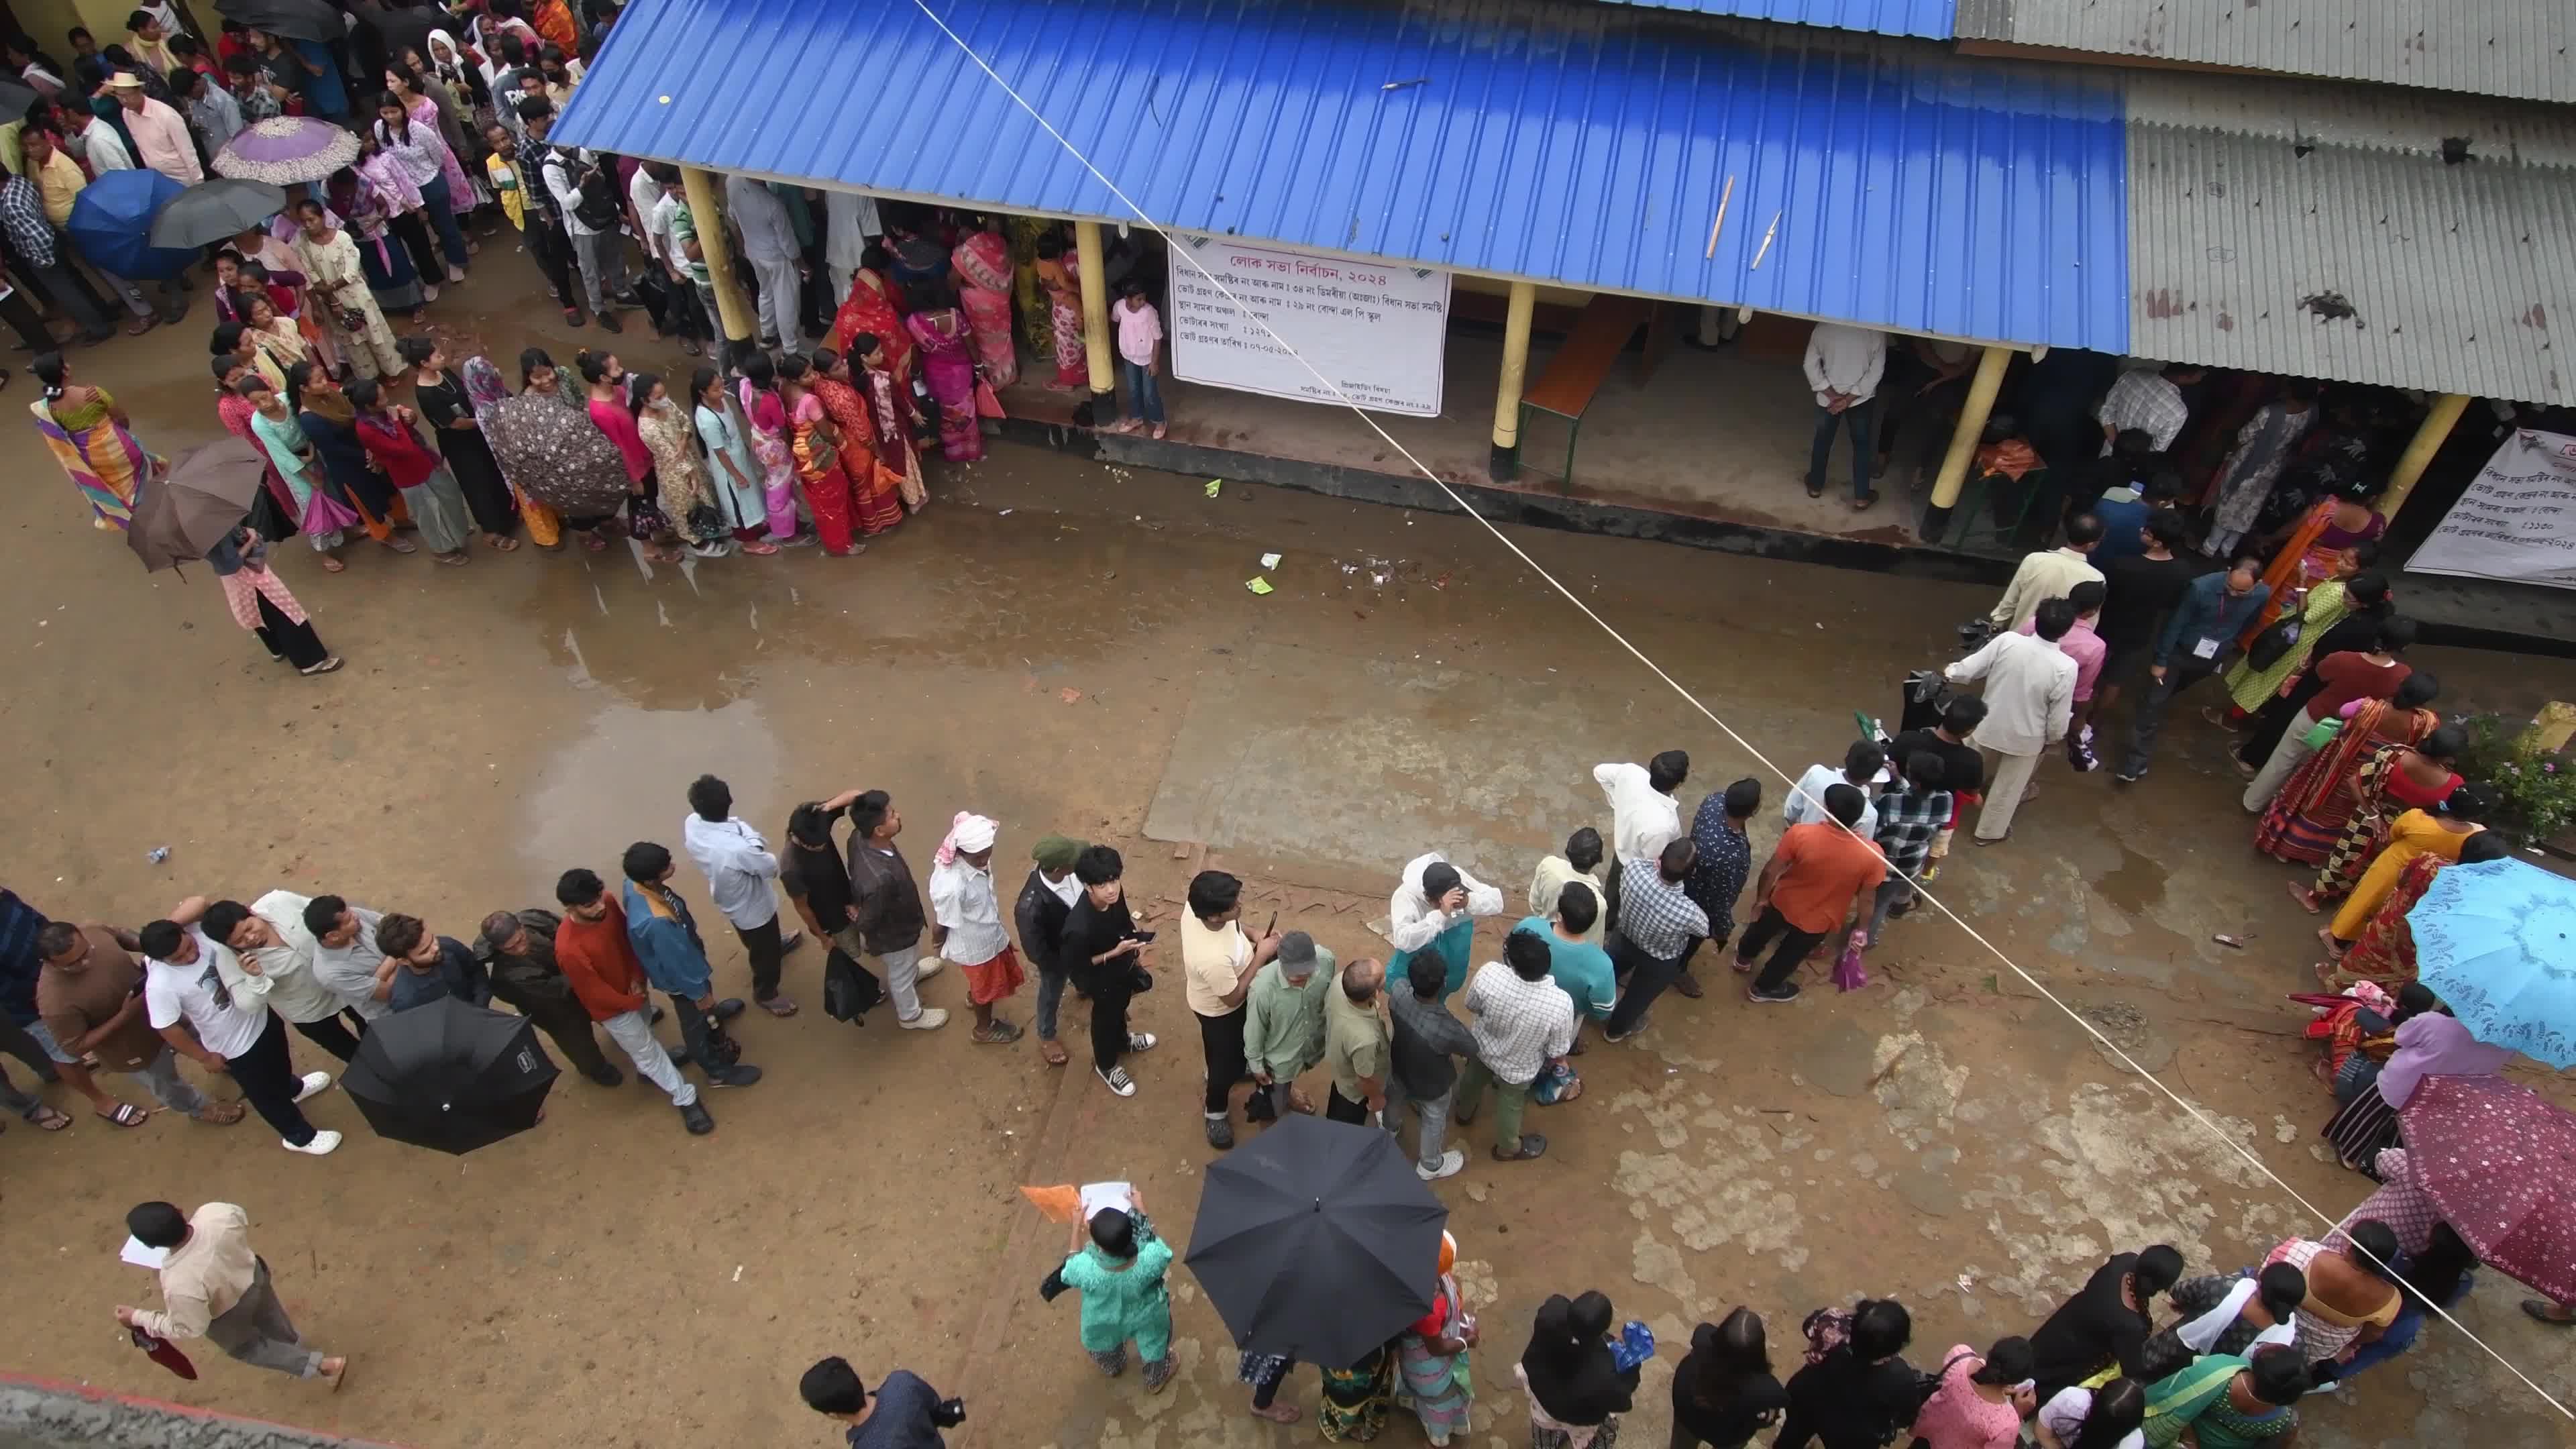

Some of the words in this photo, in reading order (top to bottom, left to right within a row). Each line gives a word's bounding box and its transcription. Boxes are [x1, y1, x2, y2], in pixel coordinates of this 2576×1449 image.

[1231, 256, 1263, 268] লোক
[1267, 260, 1290, 274] সভা
[1348, 271, 1386, 286] ২০২৪
[1177, 265, 1195, 279] বিধান
[1240, 278, 1250, 286] নং
[1271, 282, 1284, 290] নাম
[1293, 284, 1303, 293] ৩৪
[1306, 286, 1315, 295] নং
[1383, 294, 1402, 308] বিধান
[1405, 301, 1419, 311] সভা
[1178, 284, 1194, 294] ভোট
[1269, 297, 1282, 306] নাম
[1293, 301, 1304, 310] ২৯
[1306, 303, 1315, 311] নং
[1356, 307, 1364, 319] পি
[1181, 331, 1195, 341] ভোট
